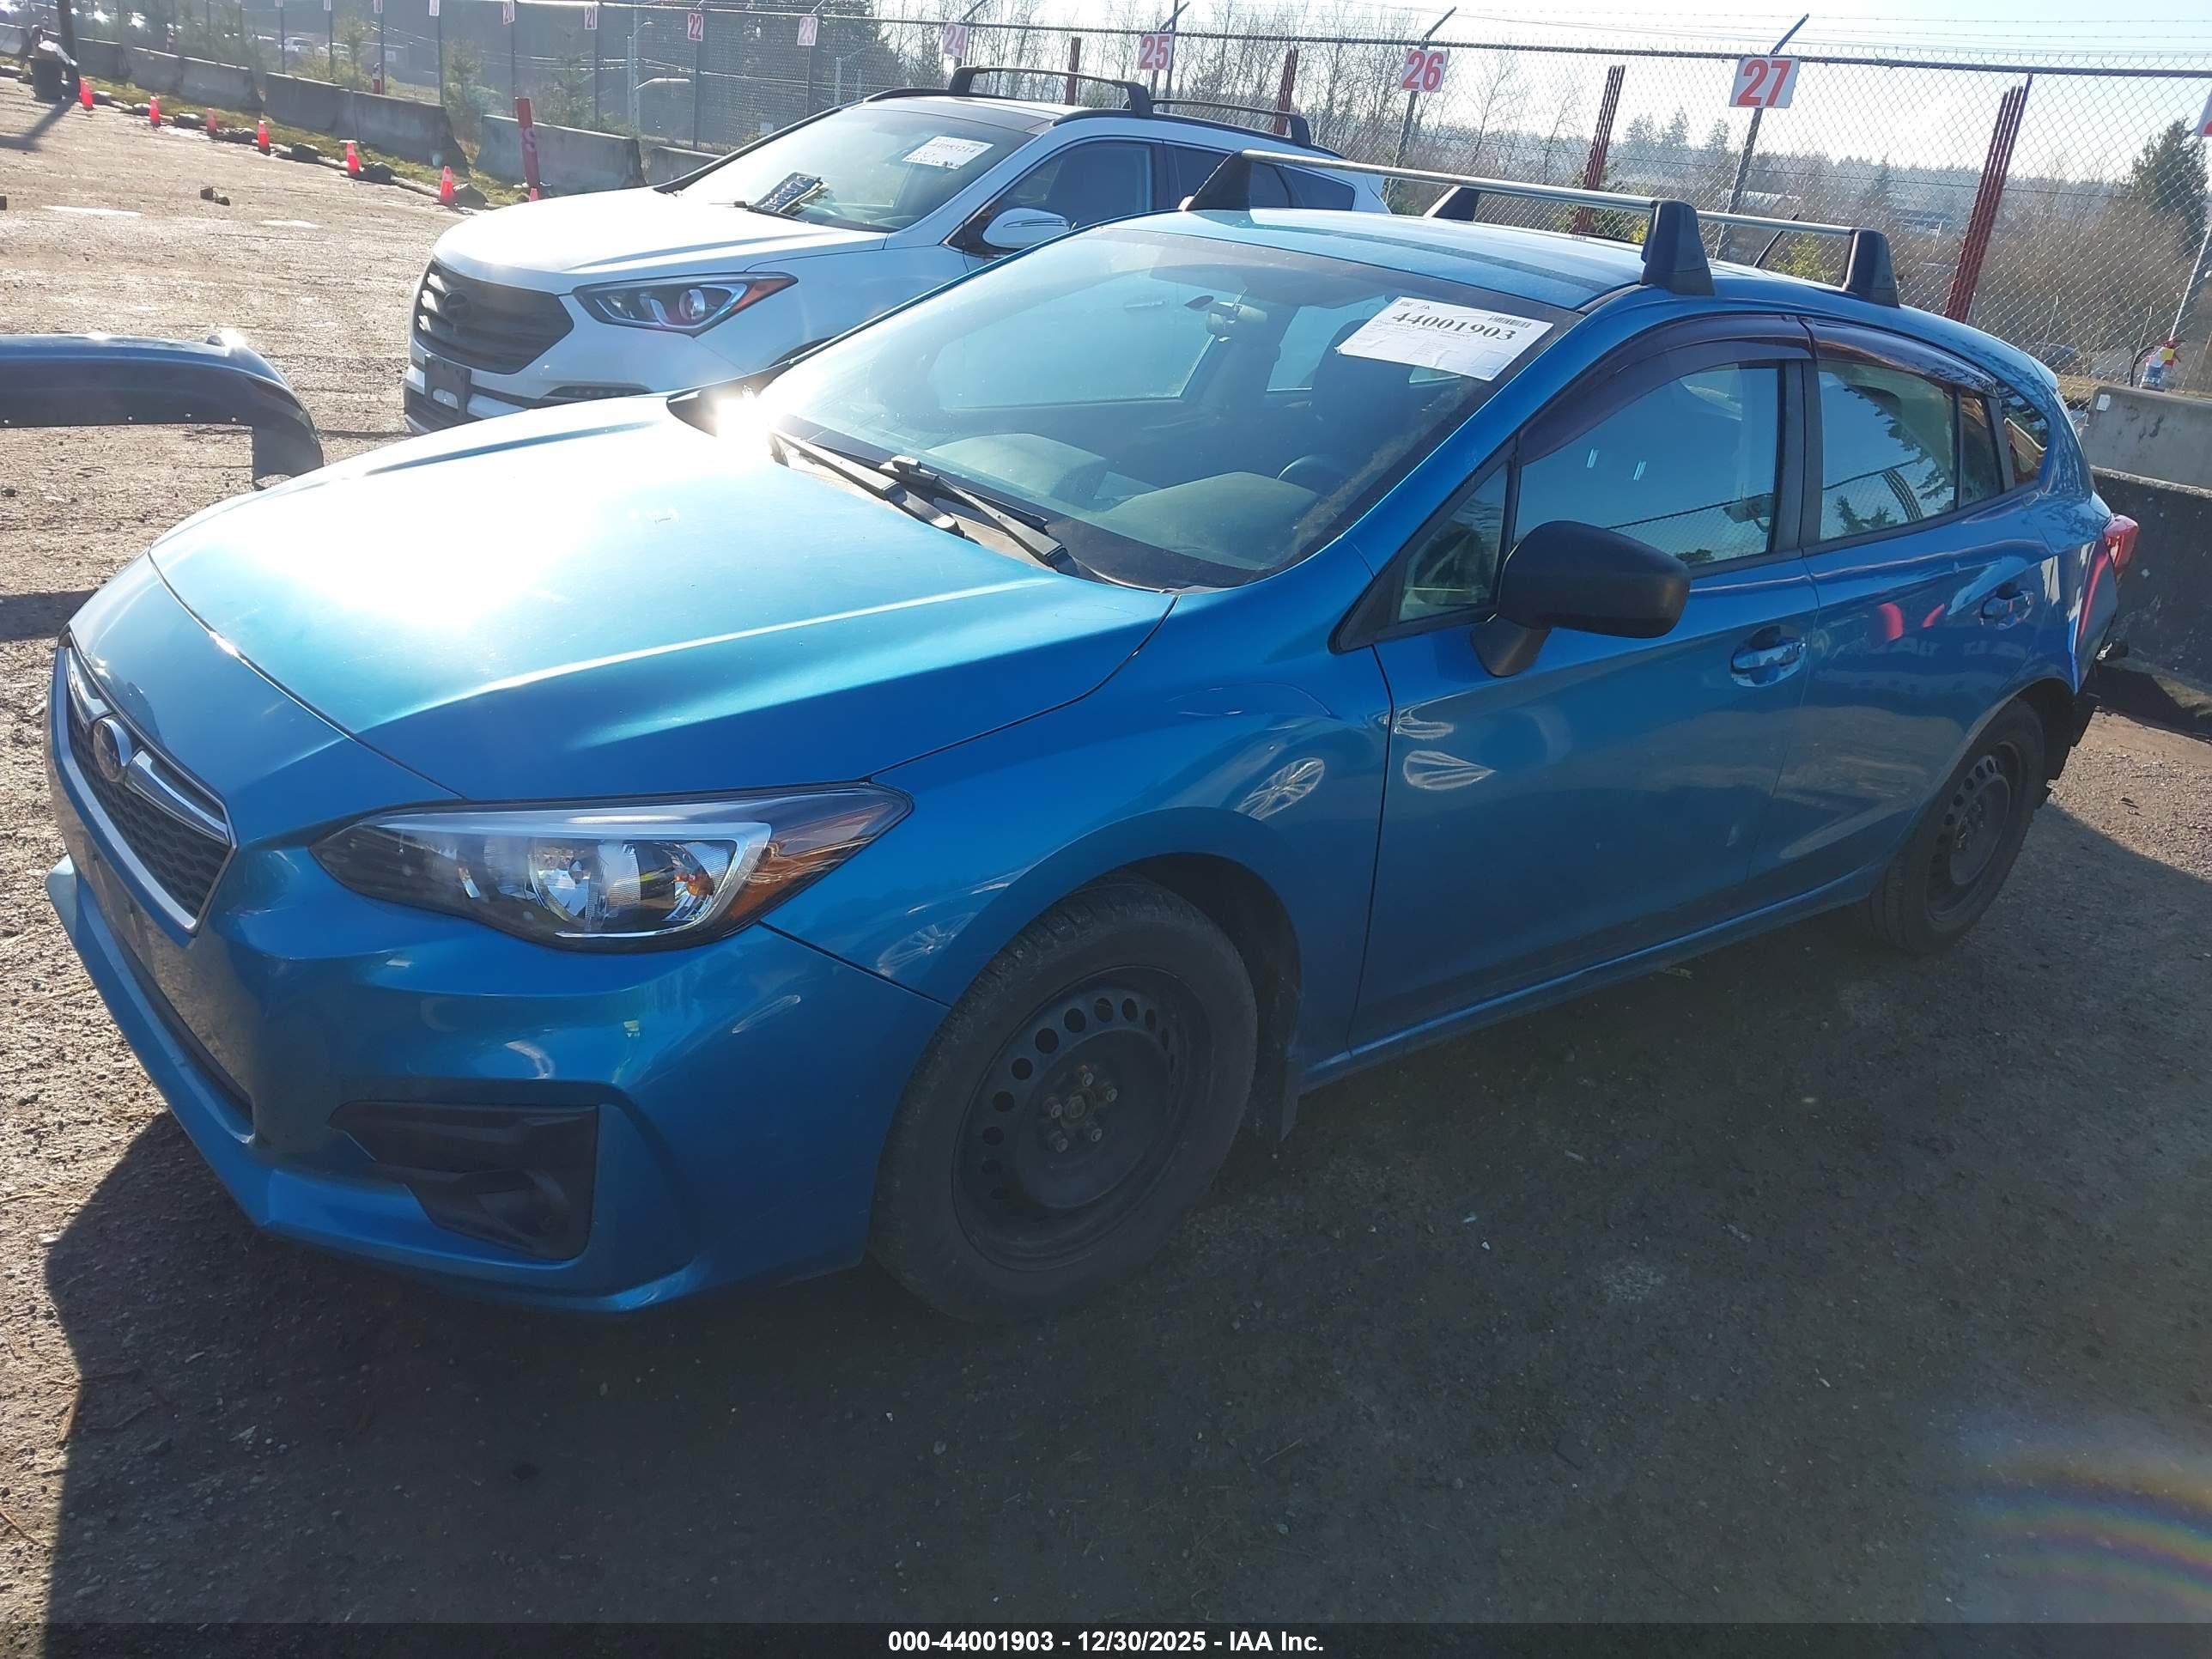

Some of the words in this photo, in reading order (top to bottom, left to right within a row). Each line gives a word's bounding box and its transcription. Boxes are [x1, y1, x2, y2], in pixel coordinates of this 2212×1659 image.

[586, 7, 596, 28] 21
[690, 14, 702, 40] 22
[799, 18, 817, 45] 23
[945, 25, 966, 57] 24
[1139, 35, 1170, 70] 25
[1402, 51, 1443, 91] 26
[1737, 59, 1792, 106] 27
[1392, 312, 1517, 341] 44001903
